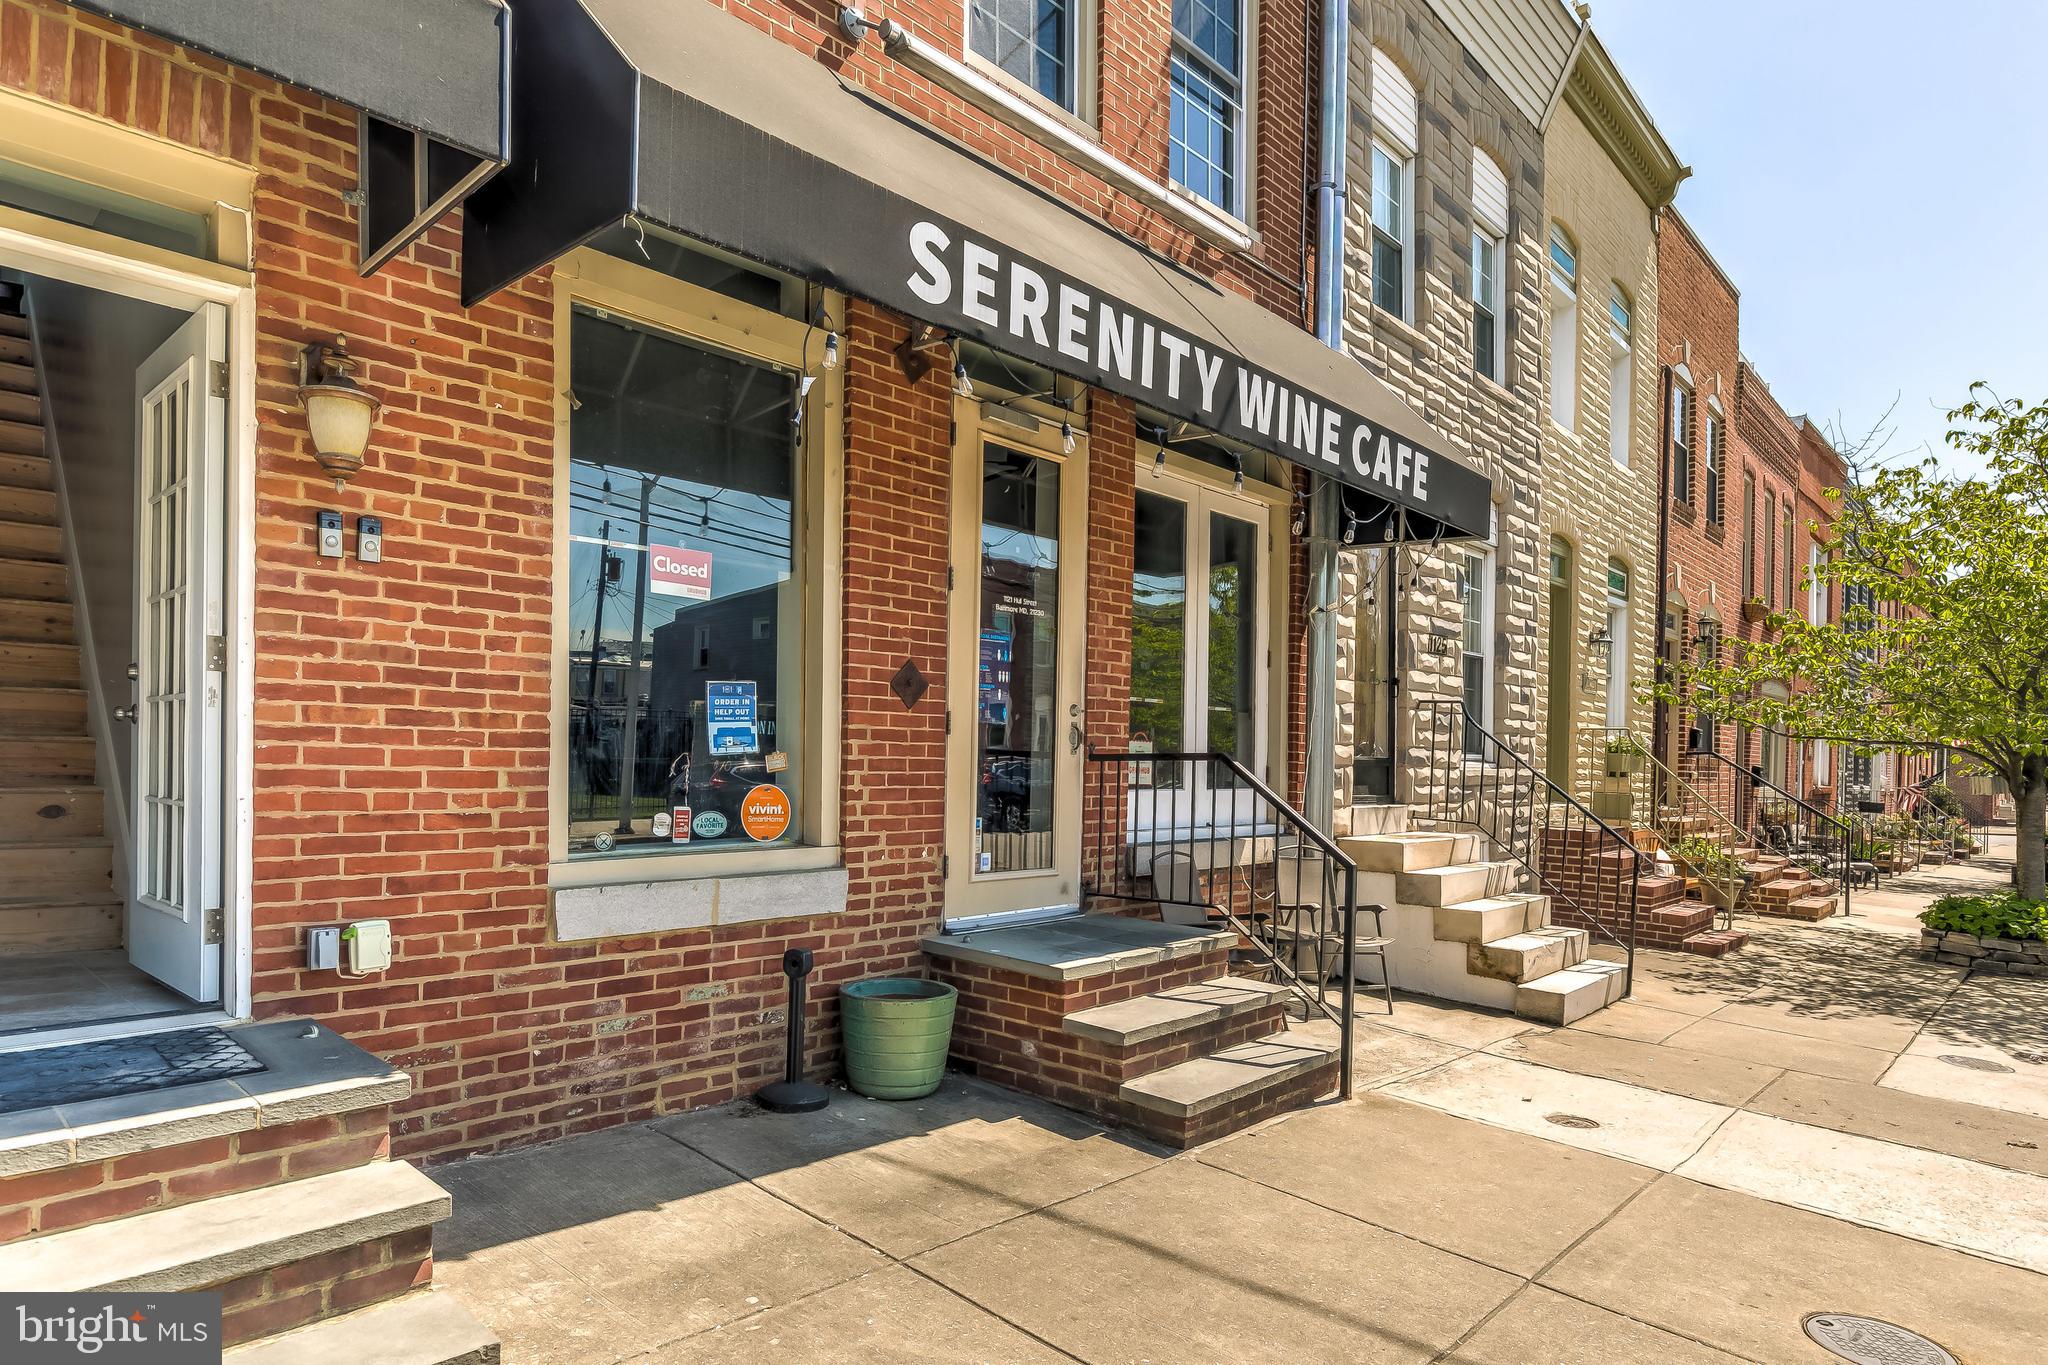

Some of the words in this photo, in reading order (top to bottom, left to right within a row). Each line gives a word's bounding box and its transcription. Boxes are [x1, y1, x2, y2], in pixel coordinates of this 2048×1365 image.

[907, 221, 1225, 413] SERENITY
[1237, 368, 1341, 466] WINE
[1351, 424, 1429, 502] CAFE
[653, 555, 708, 579] Closed
[1430, 636, 1447, 653] 1125
[714, 698, 740, 706] ORDER
[742, 698, 750, 706] IN
[748, 803, 784, 815] vivint.
[747, 815, 785, 823] SmartHome
